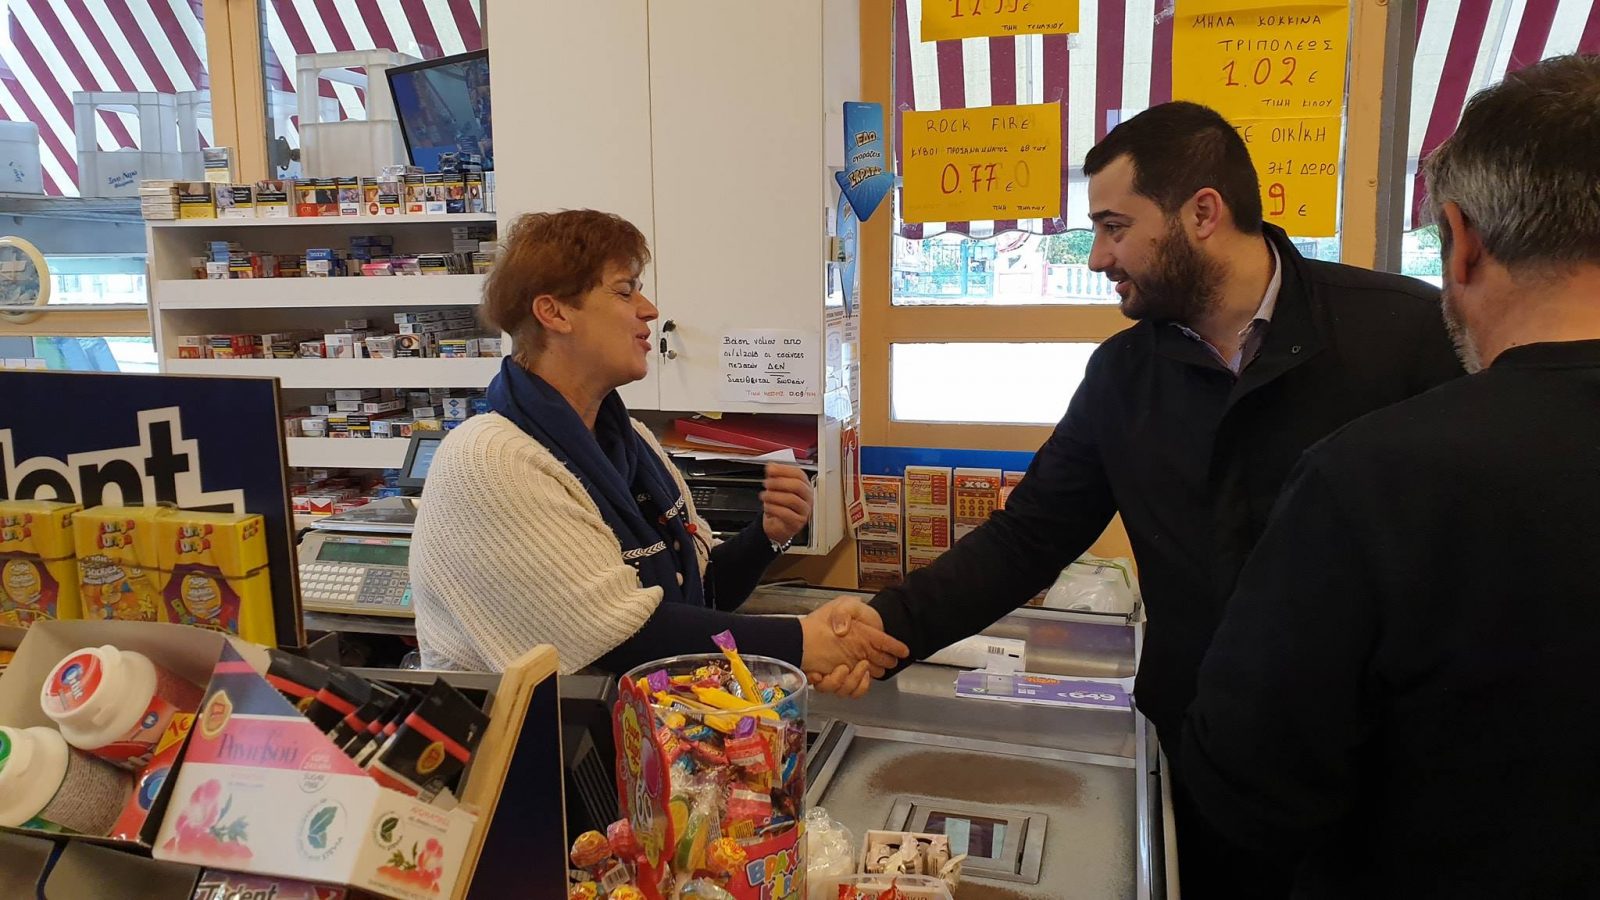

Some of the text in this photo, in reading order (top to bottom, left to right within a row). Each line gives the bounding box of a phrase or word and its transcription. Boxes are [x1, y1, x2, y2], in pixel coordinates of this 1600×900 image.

[1193, 15, 1322, 28] ΜΗΛΑ ΚΟΚΚΙΝΑ
[1217, 39, 1333, 51] ΤΡΙΠΟΛΕΩΣ
[1222, 56, 1297, 88] 1.02
[1261, 99, 1333, 108] ΤΙΜΗ ΚΙΛΟΥ
[927, 117, 1030, 133] ROCK FIRE
[1271, 121, 1327, 142] ΟΙΚ/ΚΗ
[911, 147, 938, 158] ΚΥΒΟΙ
[1267, 160, 1336, 175] 3+1 ΔΩΡΟ
[941, 163, 997, 194] 0.77
[767, 362, 785, 370] ΔΕΝ
[0, 420, 190, 507] ent
[198, 882, 280, 900] Tdent
